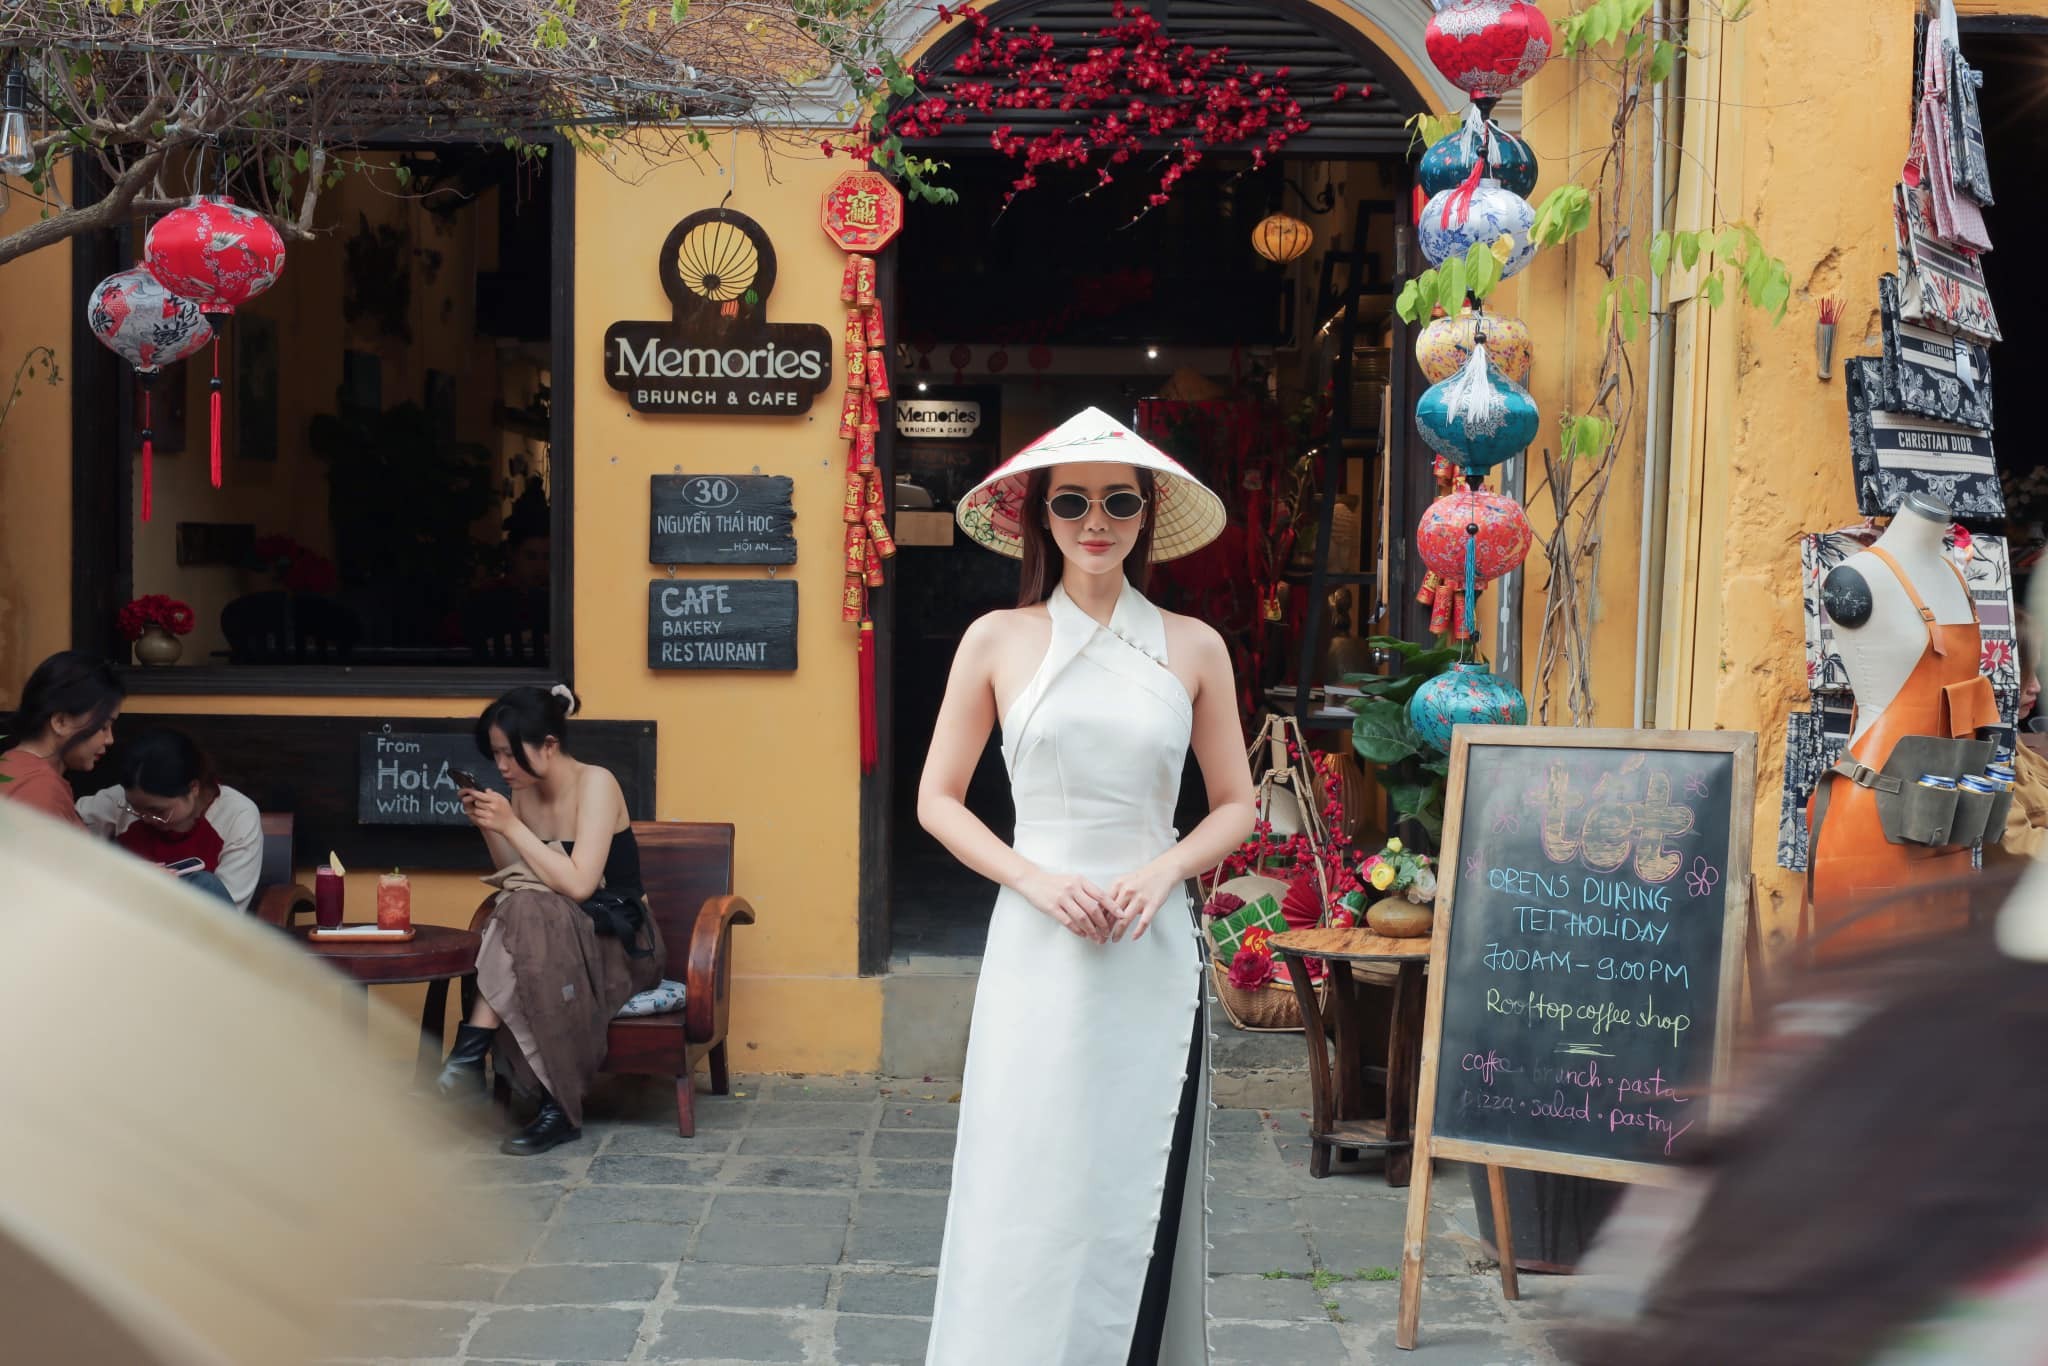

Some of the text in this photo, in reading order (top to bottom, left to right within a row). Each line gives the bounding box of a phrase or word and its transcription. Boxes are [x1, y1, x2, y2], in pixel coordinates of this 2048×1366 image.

[615, 337, 822, 379] Memories
[1922, 341, 1954, 361] CHRISTIAN
[637, 389, 798, 406] BRUNCH & CAFE
[897, 407, 976, 423] Memories
[1898, 431, 1973, 452] CHRISTIAN DIOR
[694, 479, 729, 503] 30
[656, 510, 774, 536] NGUYỄN THÁI HỌC
[754, 543, 769, 552] AN
[661, 584, 732, 617] CAFE
[662, 621, 722, 637] BAKERY
[662, 641, 768, 662] RESTAURANT
[377, 737, 420, 753] From
[433, 761, 460, 790] A
[376, 794, 420, 813] with
[1488, 868, 1673, 913] OPENS DURING
[1512, 906, 1569, 935] TET
[1486, 987, 1691, 1048] Rooftop coffee shop
[1618, 1065, 1689, 1103] pasta
[1530, 1089, 1591, 1122] salad
[1610, 1106, 1695, 1156] pastry
